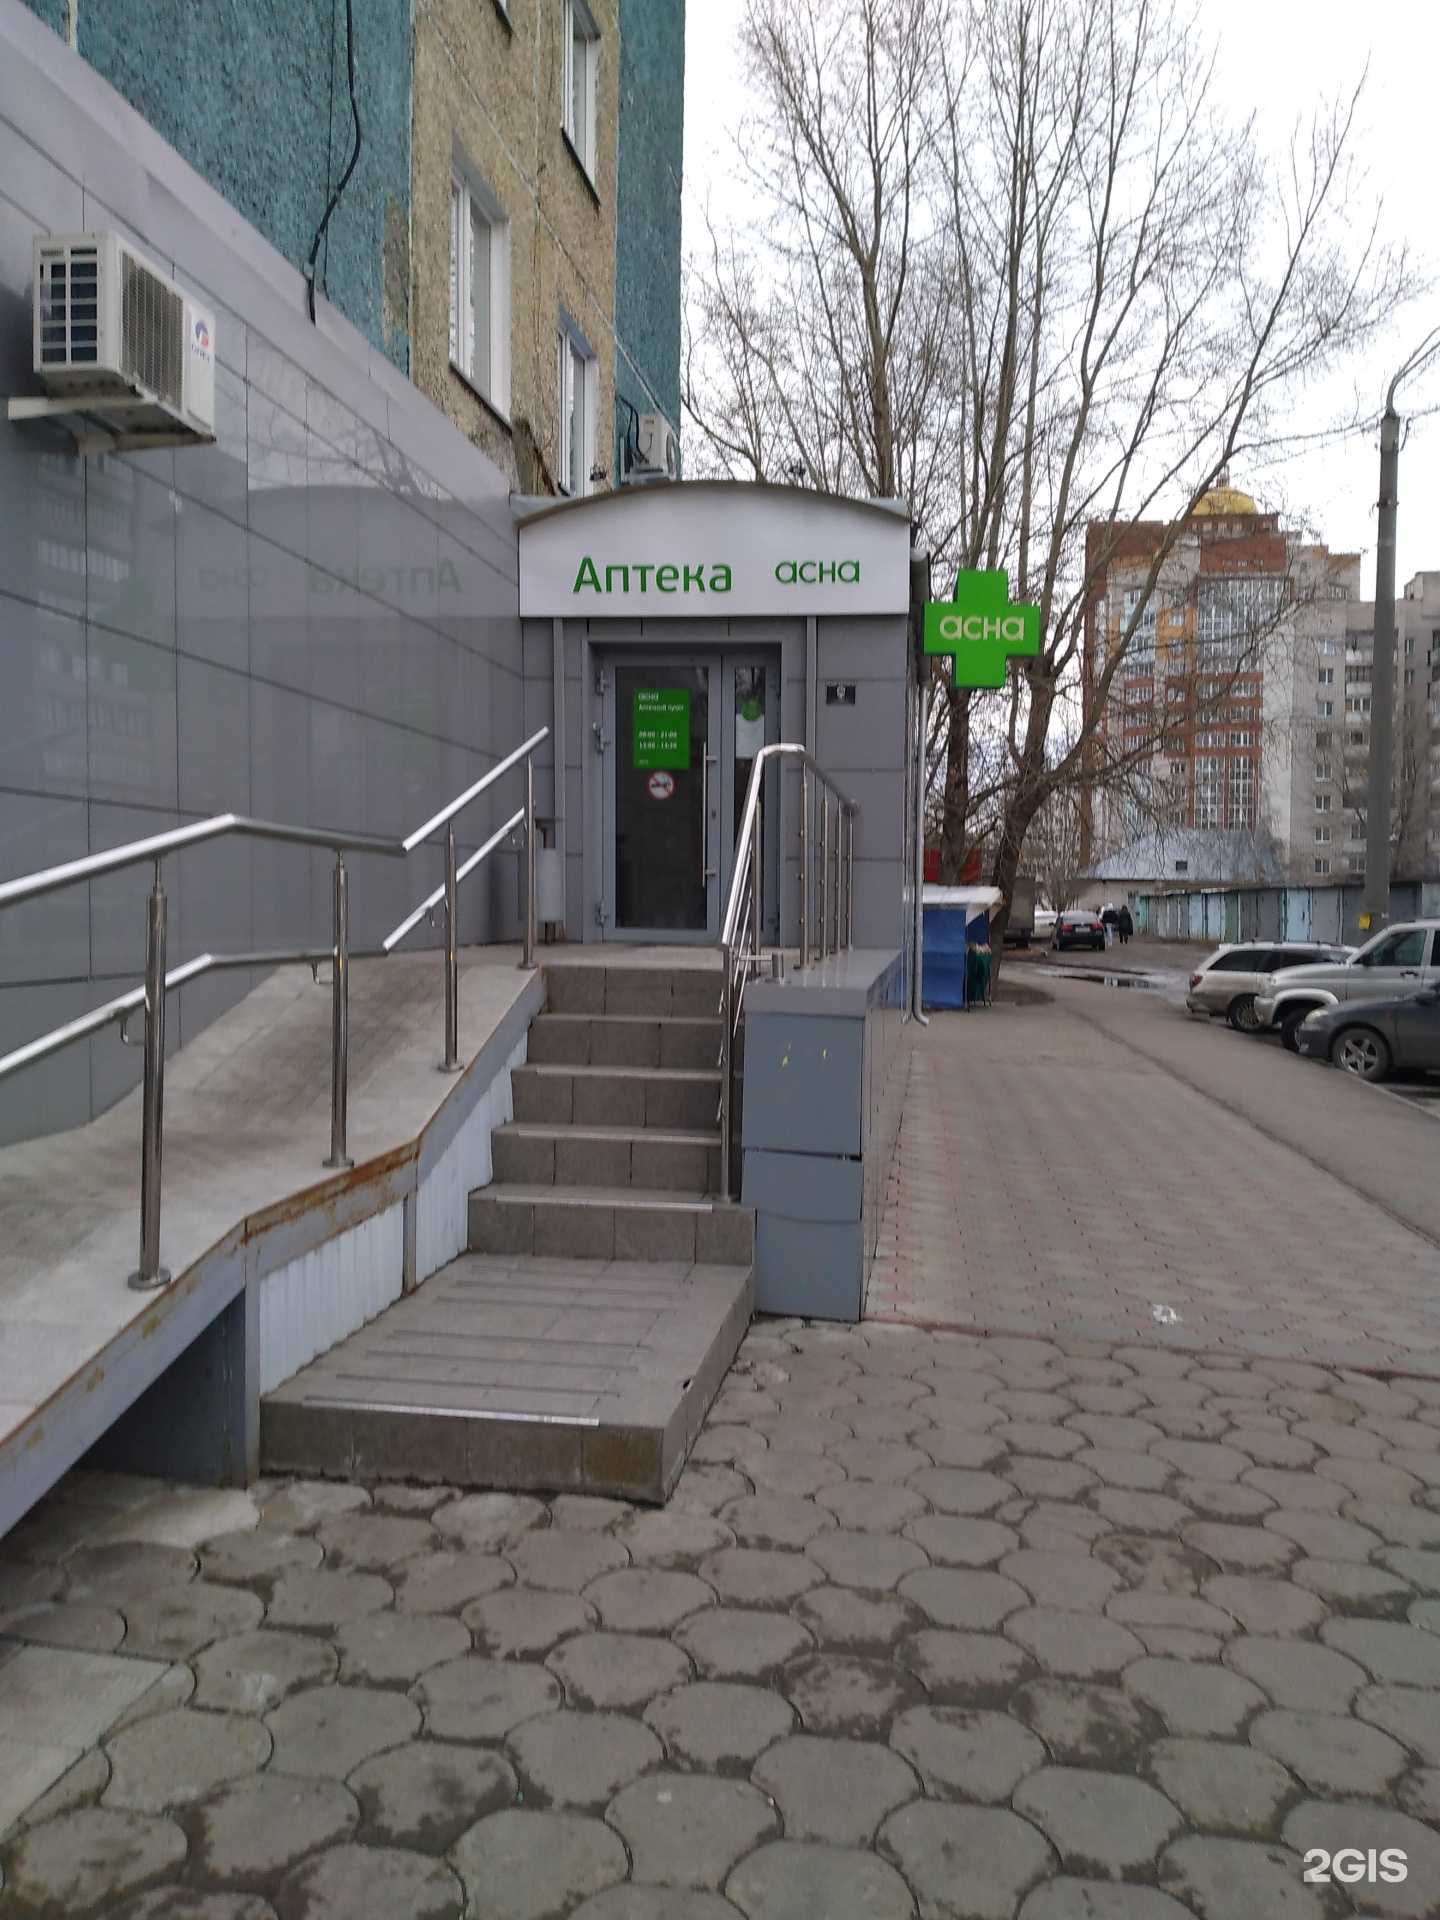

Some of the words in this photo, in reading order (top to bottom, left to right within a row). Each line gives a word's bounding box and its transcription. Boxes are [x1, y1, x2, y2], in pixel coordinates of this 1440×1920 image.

[573, 556, 733, 593] Аптека
[774, 559, 861, 585] асна
[939, 615, 1025, 641] асна
